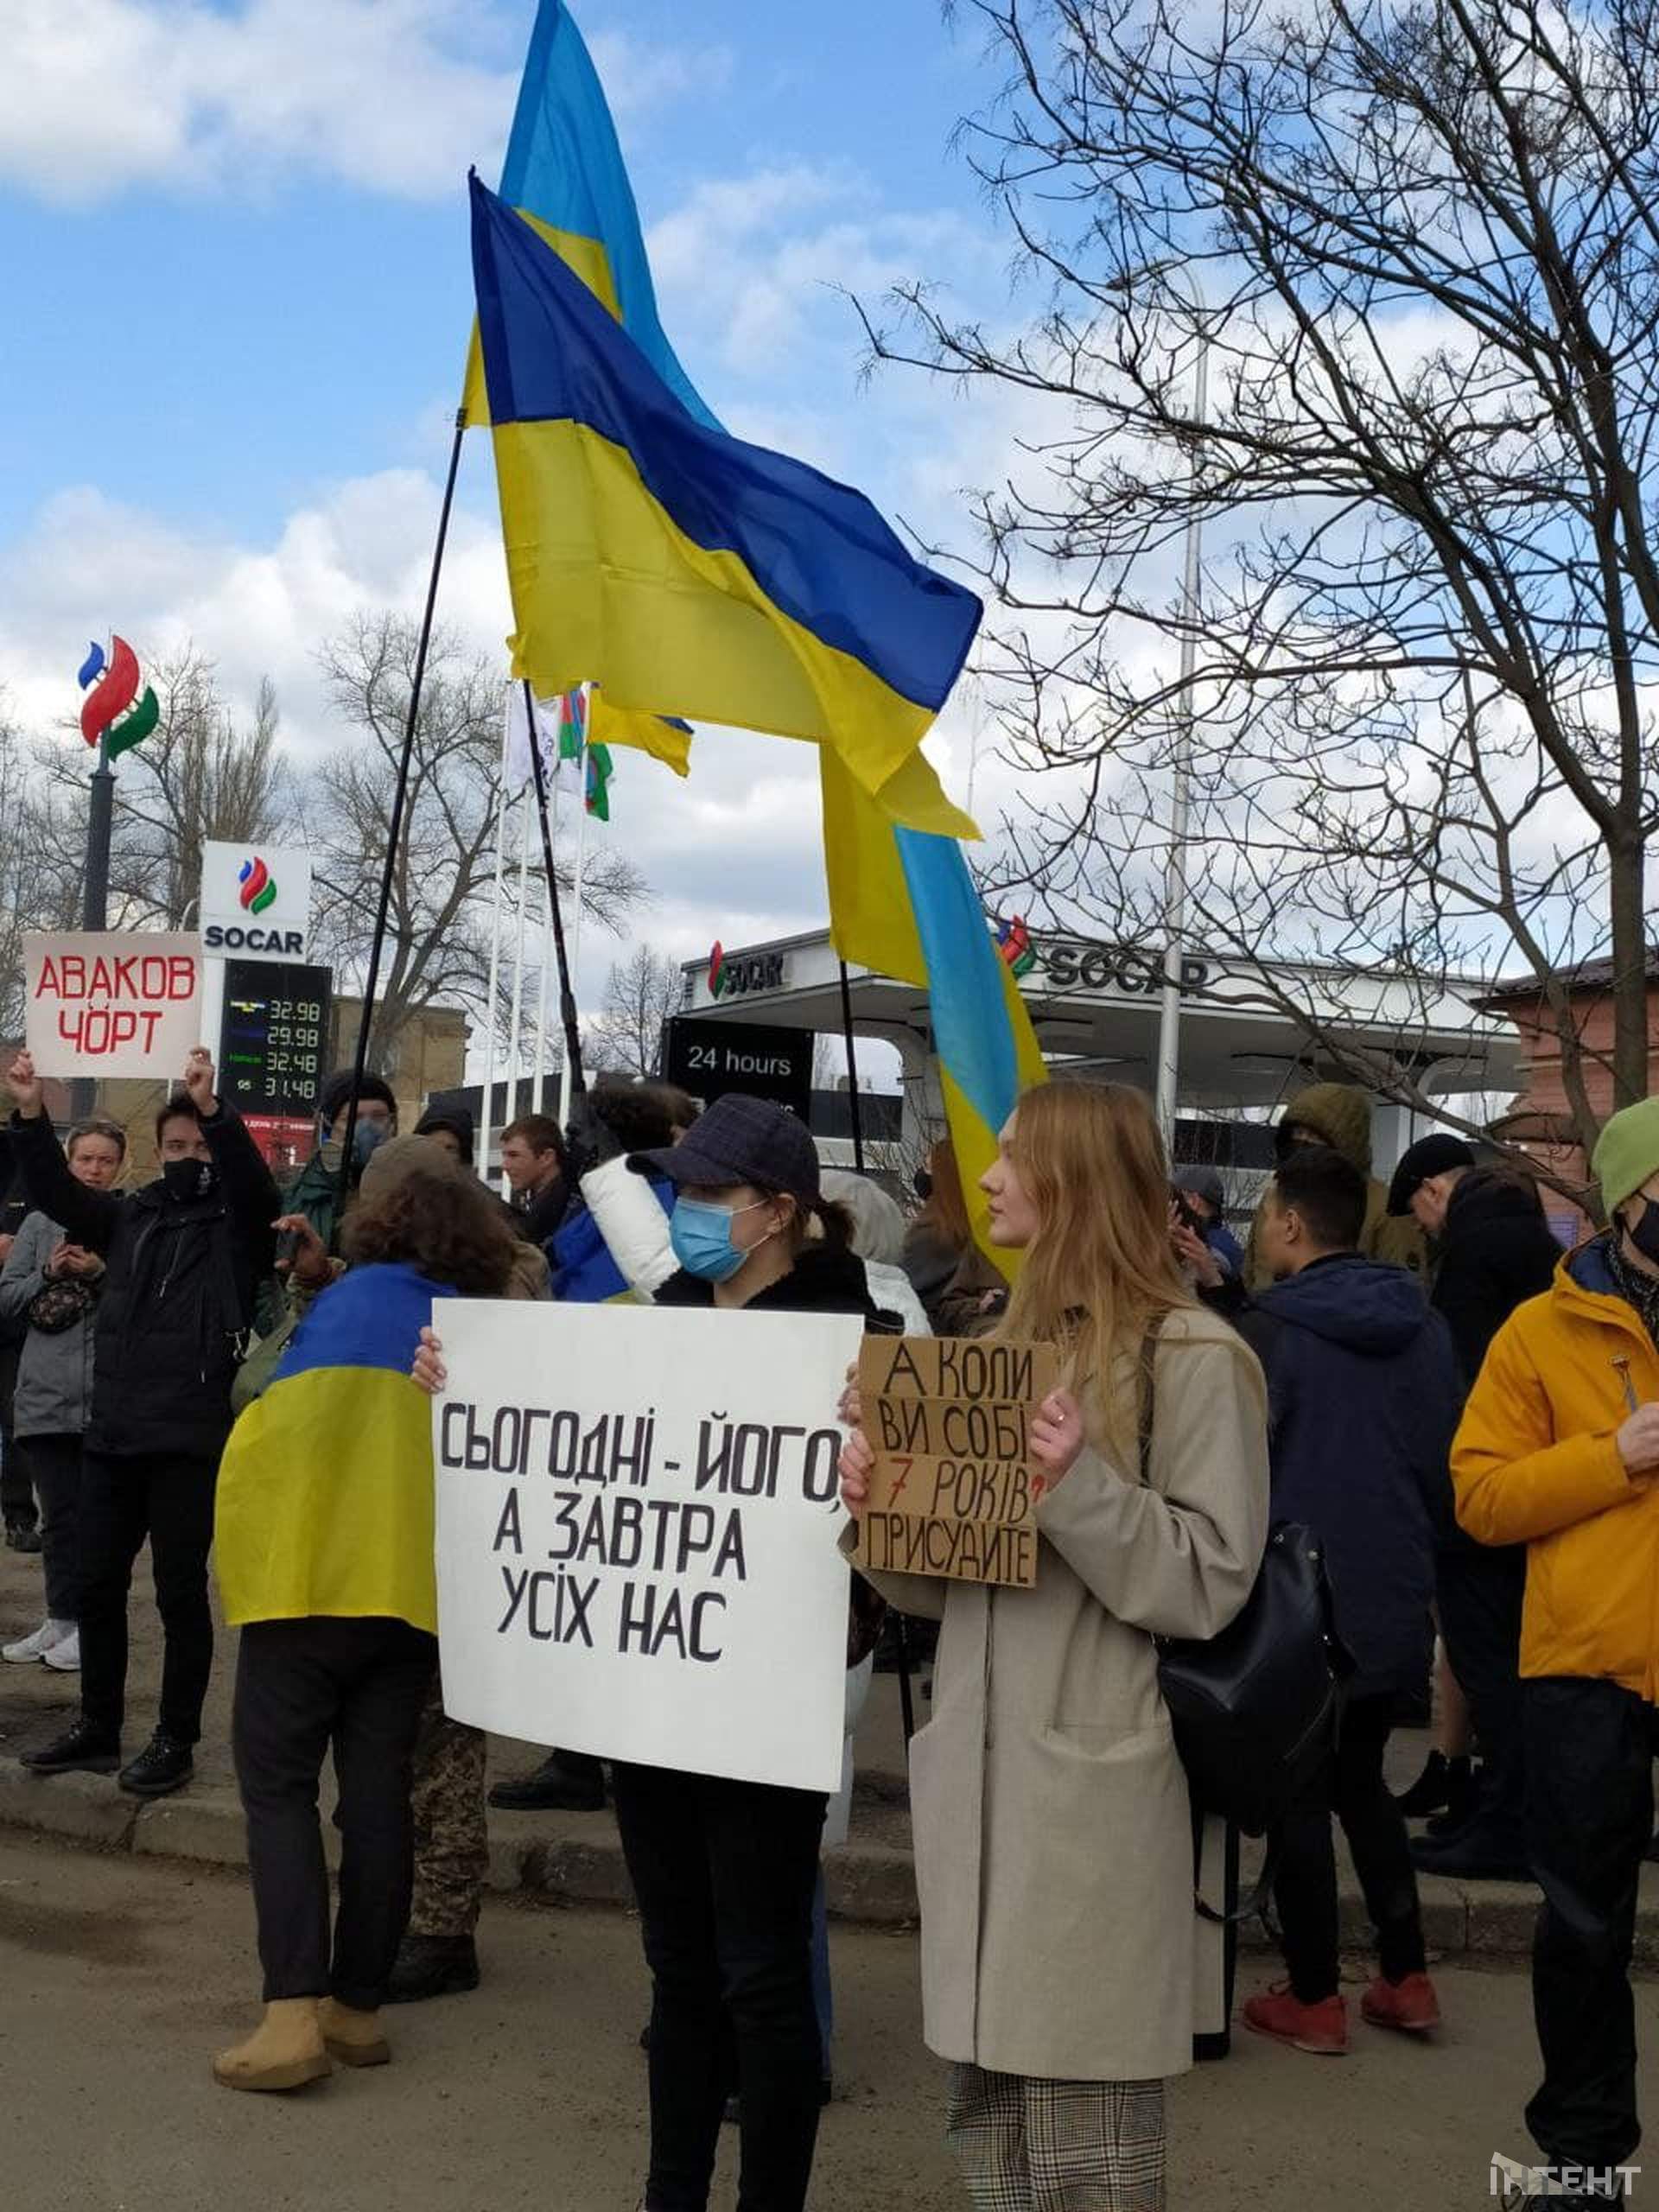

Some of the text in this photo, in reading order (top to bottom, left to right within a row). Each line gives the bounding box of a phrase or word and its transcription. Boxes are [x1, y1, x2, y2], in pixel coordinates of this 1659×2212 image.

[204, 925, 303, 954] SOCAR
[35, 956, 195, 1000] АВАКОВ
[270, 1001, 321, 1022] 32.98
[267, 1026, 319, 1047] 29.98
[266, 1052, 317, 1073] 32.48
[688, 1046, 791, 1076] 24 hours
[264, 1077, 315, 1099] 31.48
[882, 1340, 1032, 1401] А КОЛИ
[878, 1398, 1027, 1463] ВИ СОБІ
[441, 1402, 655, 1490] СЬОГОДНІ
[695, 1410, 843, 1513] ЙОГО,
[888, 1457, 912, 1507] 7
[493, 1487, 747, 1580] А ЗАВТРА
[867, 1513, 1030, 1583] ПРИСУДИТЕ
[497, 1562, 727, 1662] УСІХ НАС
